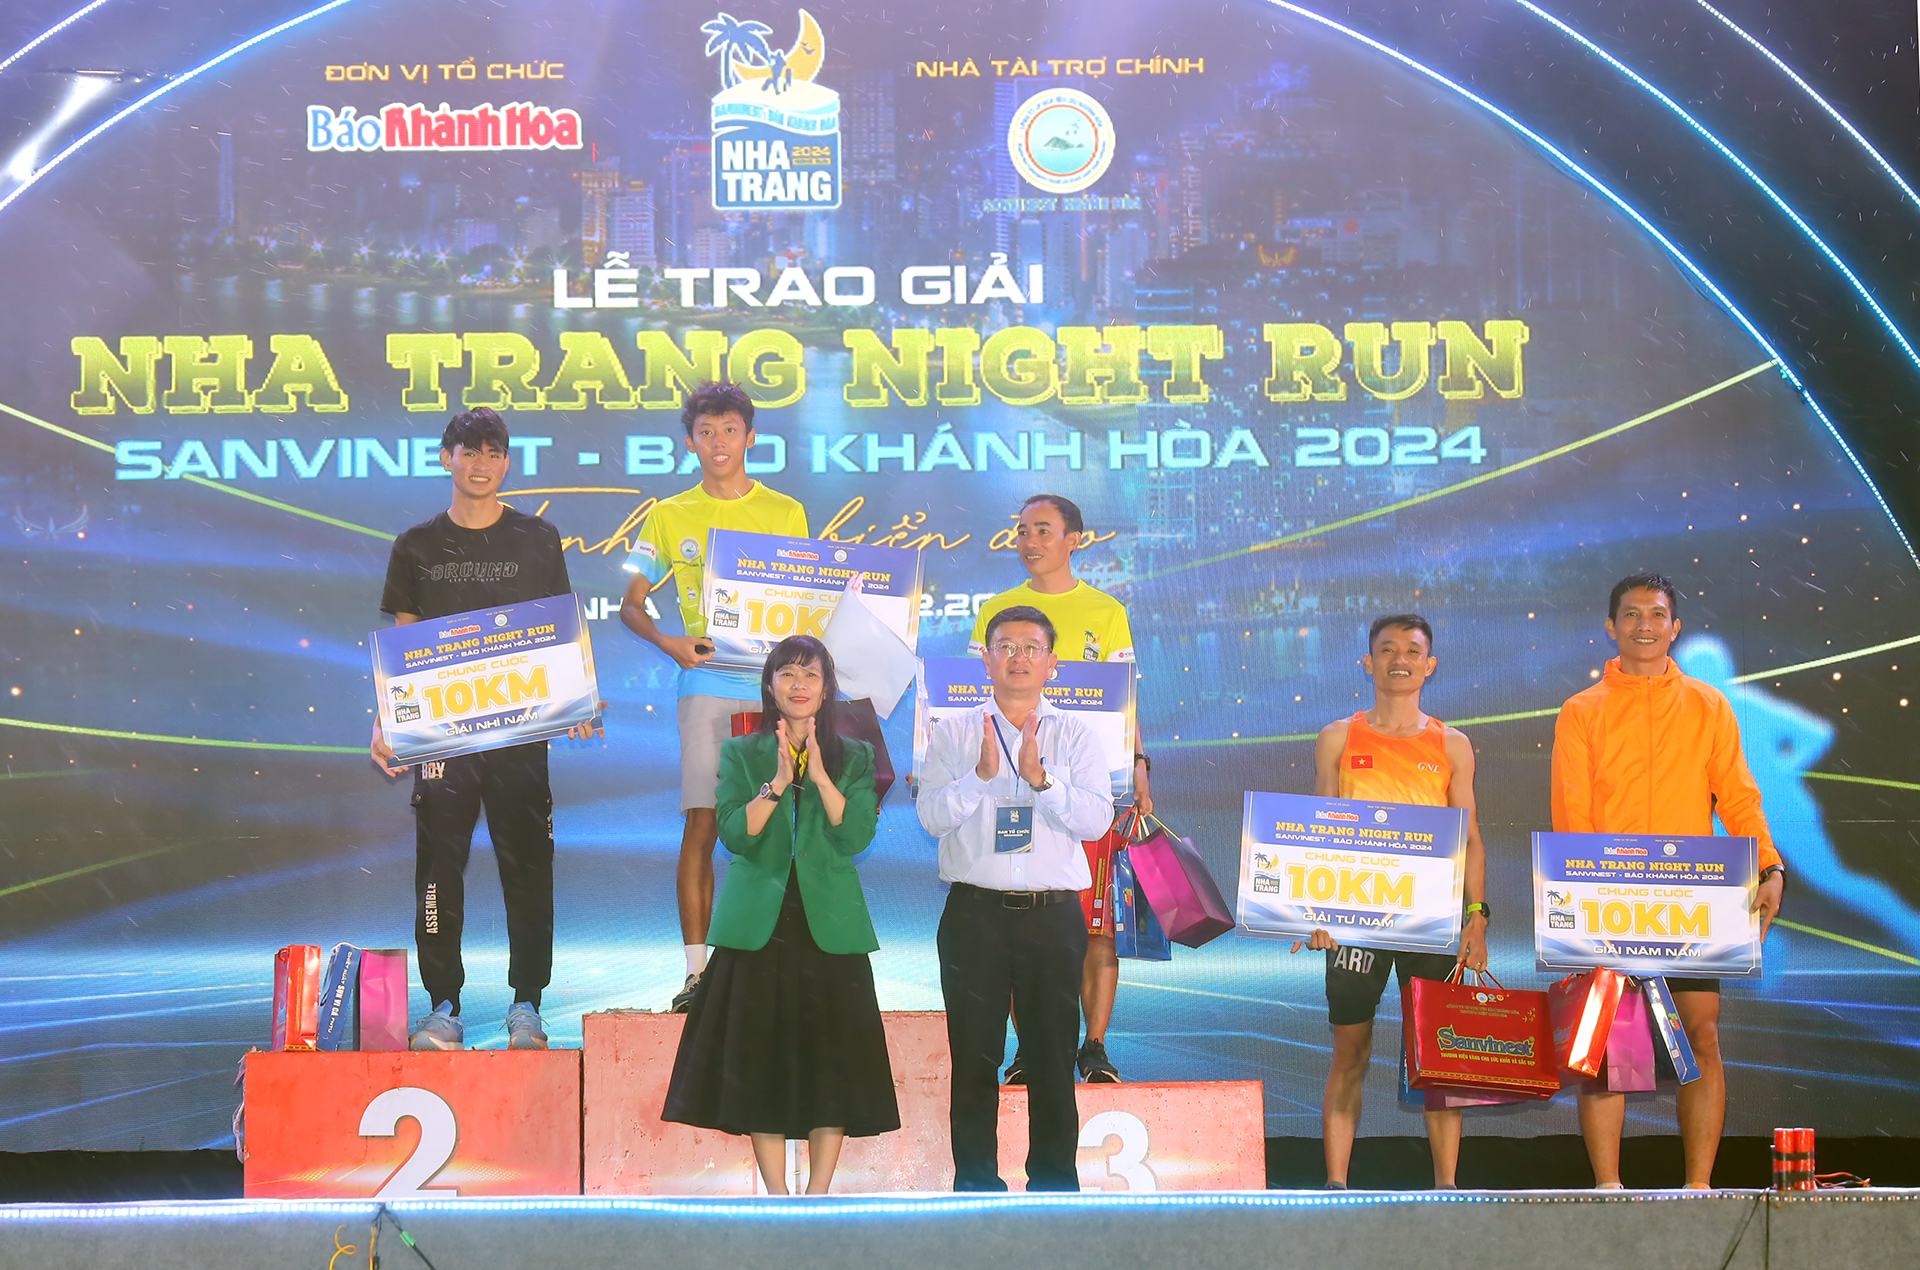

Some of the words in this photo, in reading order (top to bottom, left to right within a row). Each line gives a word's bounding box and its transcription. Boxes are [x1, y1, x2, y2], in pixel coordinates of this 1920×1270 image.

[325, 61, 390, 81] ĐƠN
[400, 64, 428, 83] VỊ
[438, 56, 477, 80] TỔ
[487, 60, 565, 80] CHỨC
[916, 58, 981, 78] NHÀ
[991, 57, 1041, 77] TÀI
[1047, 56, 1107, 80] TRỢ
[1115, 55, 1204, 75] CHÍNH
[309, 106, 382, 148] Báo
[722, 140, 791, 170] NHA
[792, 146, 831, 157] 2024
[721, 170, 832, 202] TRANG
[552, 251, 639, 308] LỄ
[664, 265, 877, 308] TRAO
[901, 251, 1044, 306] GIẢI
[71, 334, 350, 415] NHA
[386, 328, 806, 412] TRANG
[842, 324, 1224, 408] NIGHT
[1263, 319, 1530, 403] RUN
[115, 435, 552, 481] SANVINET
[811, 422, 1083, 475] KHÁNH
[1108, 420, 1269, 470] HÒA
[1295, 425, 1488, 468] 2024
[431, 561, 518, 581] GROUND
[736, 569, 786, 580] SANVINEST
[793, 574, 812, 583] BÁO
[813, 577, 845, 586] KHÁNH
[737, 558, 767, 570] NHA
[771, 562, 815, 575] TRANG
[863, 572, 891, 583] RUN
[765, 588, 815, 601] CHUNG
[819, 593, 842, 603] CU
[715, 619, 737, 627] TRANG
[745, 598, 836, 639] 10K
[404, 648, 433, 661] NHA
[436, 639, 481, 654] TRANG
[483, 630, 524, 645] NIGHT
[527, 624, 556, 637] RUN
[405, 654, 454, 669] SANVINEST
[461, 648, 480, 659] BÁO
[481, 642, 513, 655] KHÁNH
[514, 638, 533, 648] HÒA
[534, 635, 557, 644] 2024
[438, 663, 487, 680] CHUNG
[491, 655, 530, 669] CUỘC
[423, 665, 549, 720] 10KM
[948, 685, 977, 694] NHA
[1075, 688, 1103, 698] RUN
[445, 724, 473, 737] GIẢI
[476, 717, 501, 731] NHÌ
[504, 712, 539, 726] NAM
[422, 762, 445, 779] BOY
[1417, 762, 1441, 773] GNL
[1275, 833, 1326, 842] SANVINEST
[1333, 837, 1353, 845] BÁO
[1354, 839, 1387, 848] KHÁNH
[1388, 841, 1408, 849] HÒA
[1276, 821, 1306, 832] NHA
[1310, 824, 1355, 836] TRANG
[1359, 828, 1401, 840] NIGHT
[1404, 831, 1433, 843] RUN
[1305, 852, 1356, 863] CHUNG
[1361, 856, 1400, 868] CUỘC
[1565, 859, 1596, 869] NHA
[1600, 860, 1645, 870] TRANG
[1649, 862, 1691, 872] NIGHT
[1695, 863, 1725, 873] RUN
[1255, 878, 1270, 886] NHA
[1286, 863, 1416, 910] 10KM
[1565, 870, 1617, 878] SANVINEST
[1646, 872, 1678, 880] KHÁNH
[1255, 885, 1279, 893] TRANG
[1598, 887, 1649, 897] CHUNG
[1653, 887, 1694, 899] CUỘC
[426, 882, 439, 934] ASSEMBLE
[1303, 911, 1331, 923] GIẢI
[1335, 915, 1356, 924] TƯ
[1359, 917, 1395, 928] NAM
[1550, 914, 1565, 922] NHA
[1579, 898, 1712, 939] 10KM
[1550, 921, 1574, 929] TRANG
[1594, 944, 1622, 955] GIẢI
[1626, 946, 1662, 956] NĂM
[1665, 948, 1701, 957] NAM
[1437, 1024, 1534, 1058] Sanvinest
[358, 1087, 457, 1197] 2
[1079, 1110, 1157, 1192] 3
